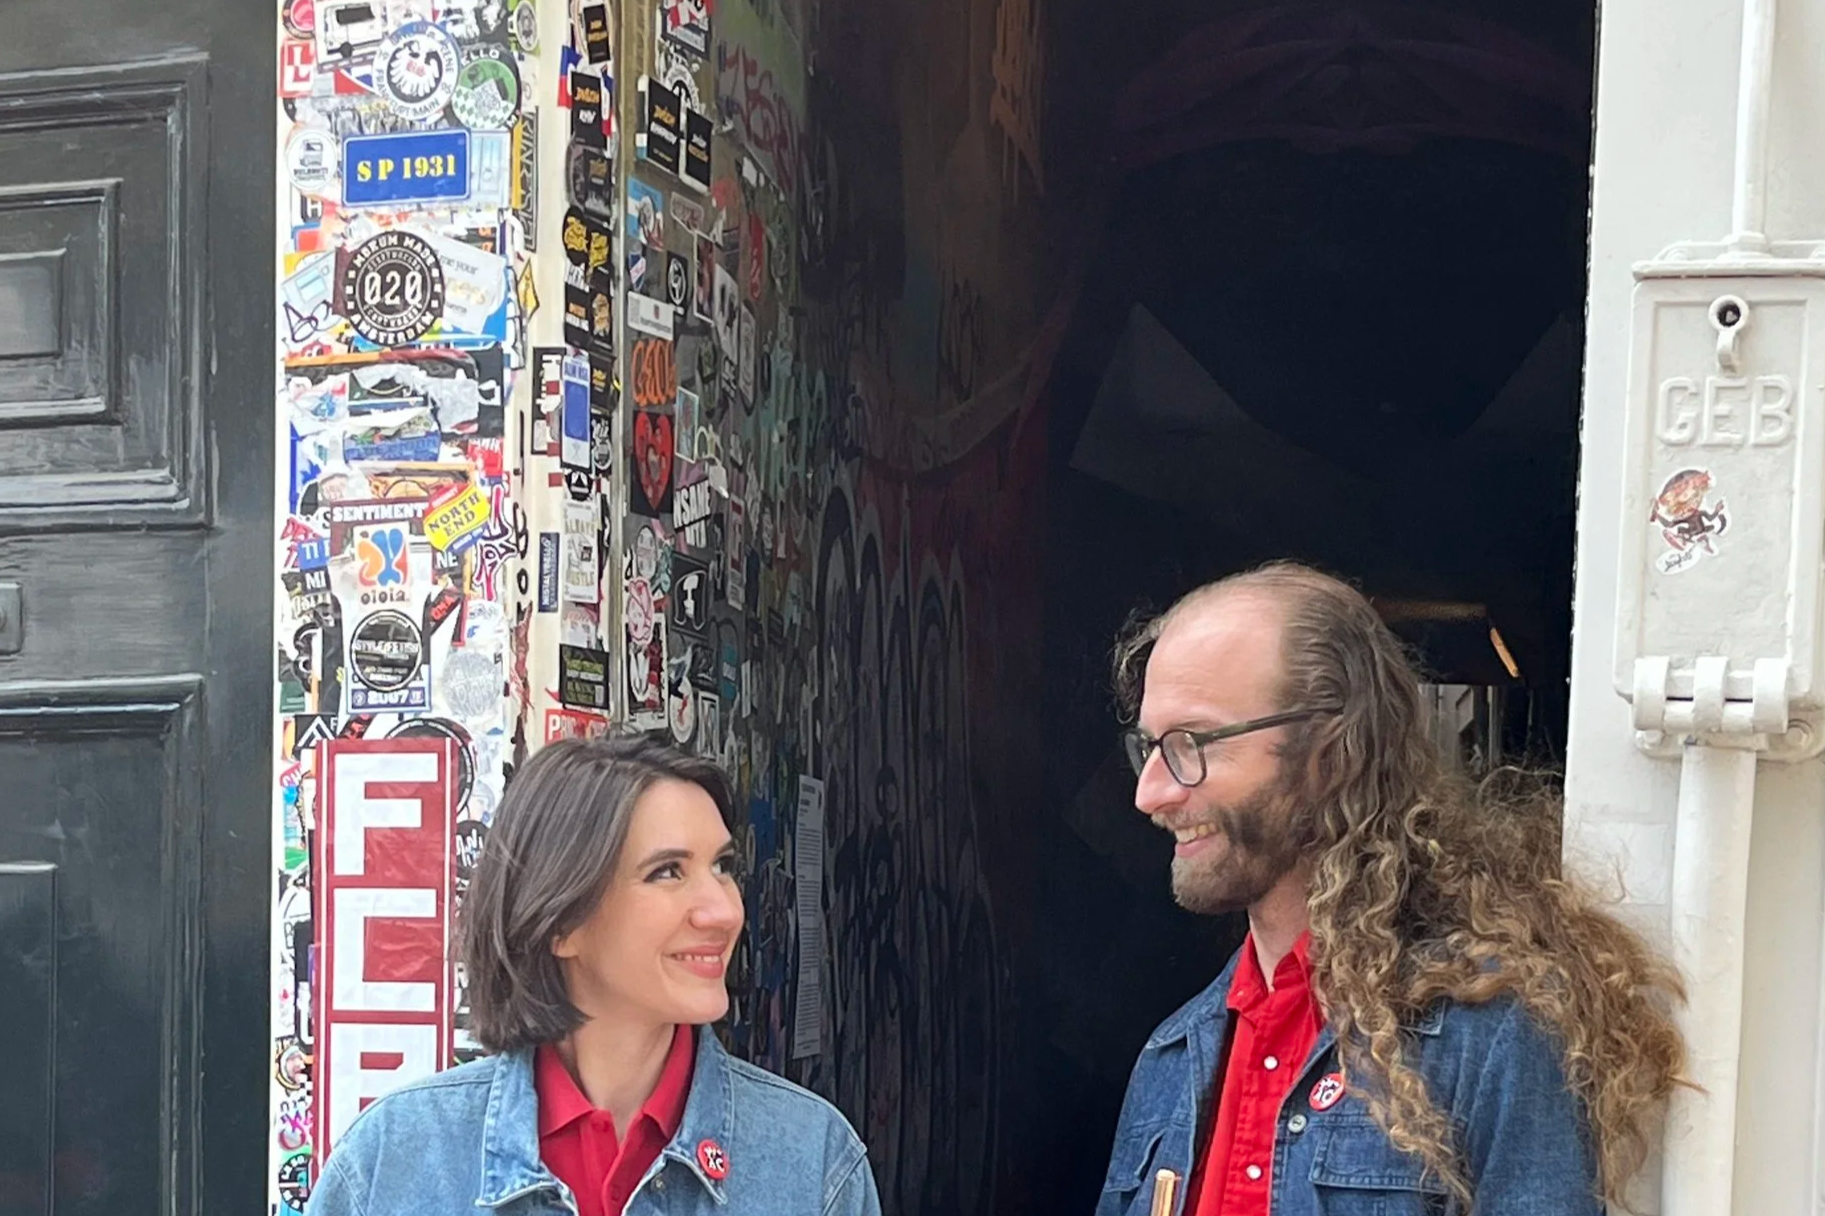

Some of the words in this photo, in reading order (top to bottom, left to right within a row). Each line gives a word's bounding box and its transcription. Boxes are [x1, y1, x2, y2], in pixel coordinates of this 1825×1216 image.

[402, 153, 456, 180] 1931
[352, 234, 399, 268] MOKUM
[402, 235, 436, 267] MADE
[363, 269, 423, 307] 020
[349, 310, 435, 345] AMSTERDAM
[1656, 375, 1797, 449] GEB
[427, 491, 482, 533] NORTH
[442, 509, 477, 538] END
